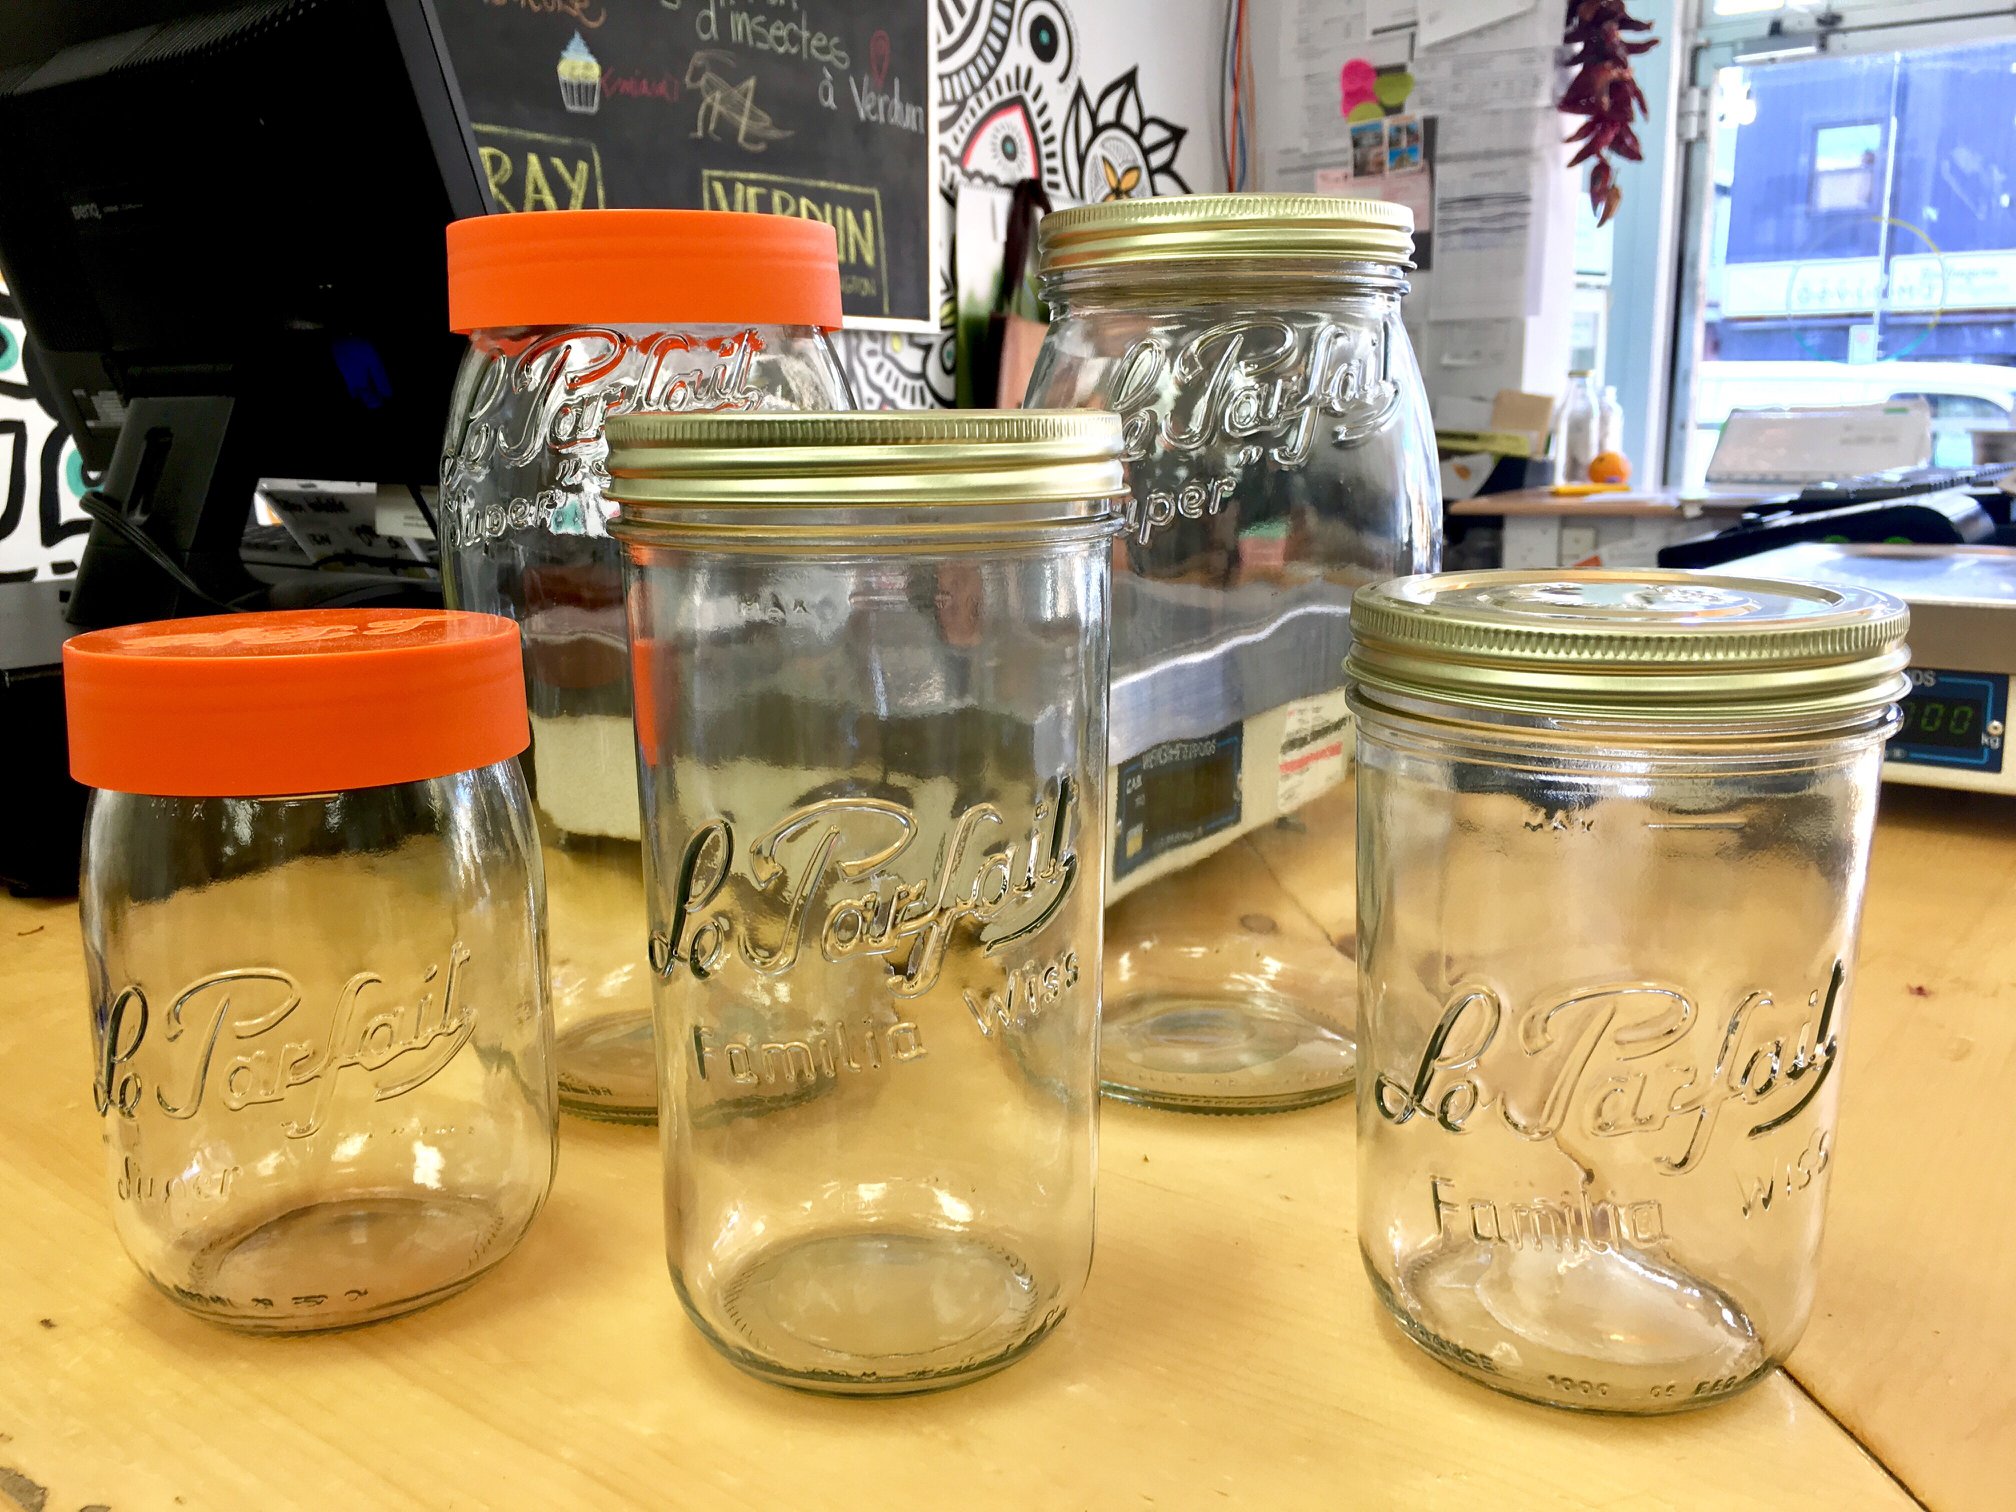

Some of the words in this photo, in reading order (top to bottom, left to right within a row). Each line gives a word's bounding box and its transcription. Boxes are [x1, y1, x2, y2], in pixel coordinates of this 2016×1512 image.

[849, 74, 926, 135] Verdun
[497, 327, 766, 487] Parfait
[1162, 319, 1403, 470] Parfait
[1110, 475, 1239, 547] uper
[648, 818, 735, 980] Le
[738, 772, 1080, 999] Parfait
[157, 940, 480, 1140] Parfait
[693, 1015, 929, 1085] Familia
[1374, 983, 1502, 1134] Le
[1498, 957, 1844, 1177] Parfait
[1430, 1173, 1672, 1254] Familia
